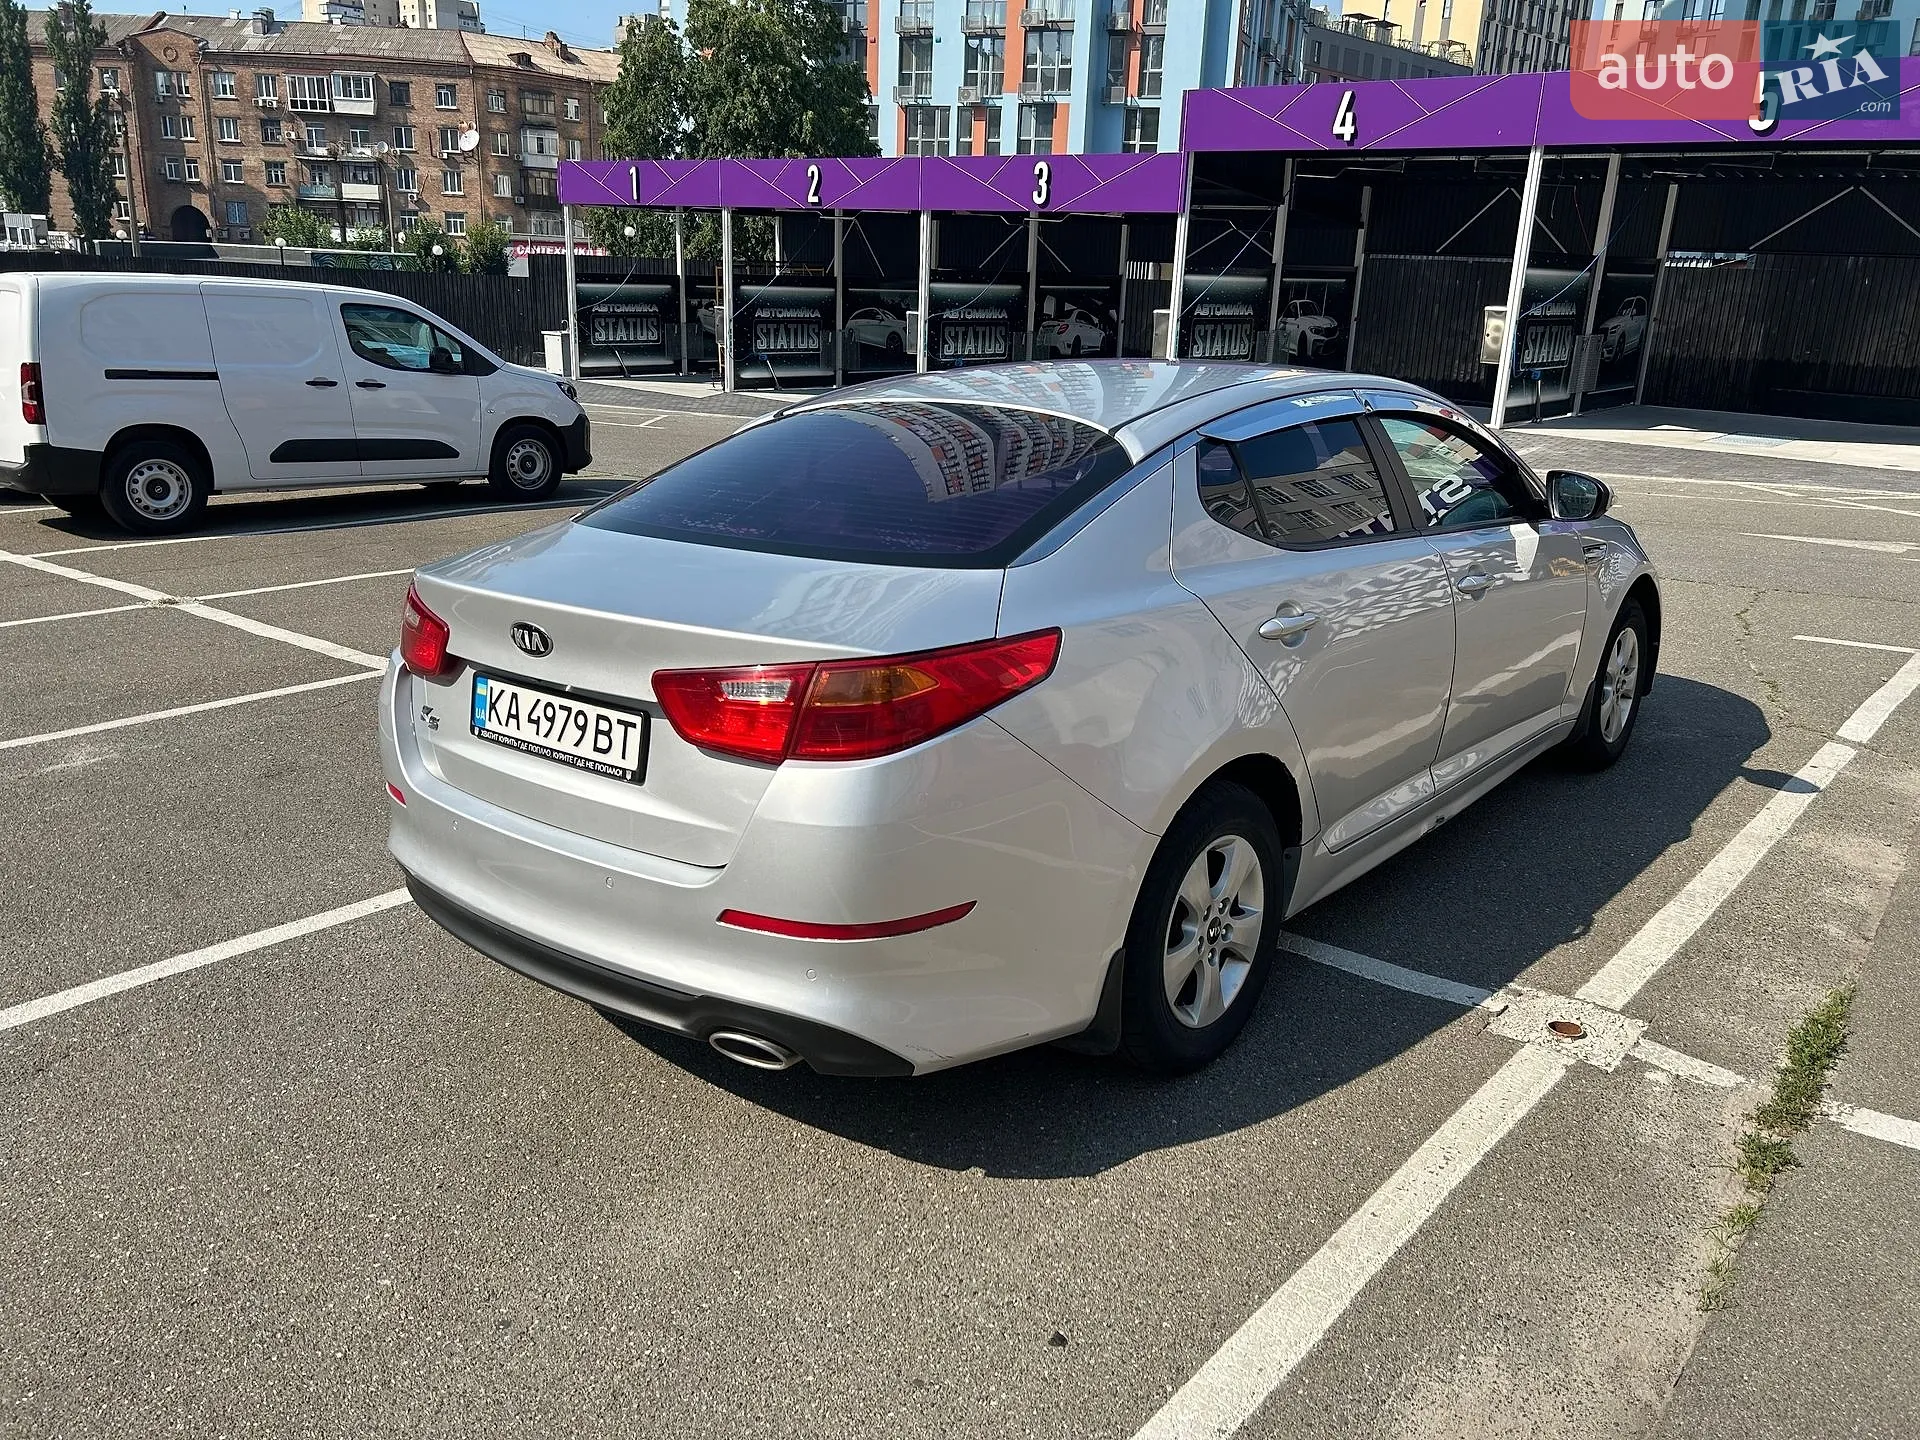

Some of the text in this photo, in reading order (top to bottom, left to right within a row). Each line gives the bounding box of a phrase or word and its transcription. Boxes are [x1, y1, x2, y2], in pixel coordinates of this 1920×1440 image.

[1332, 91, 1356, 142] 4
[1748, 71, 1778, 132] 5
[629, 166, 638, 201] 1
[808, 164, 820, 203] 2
[1032, 161, 1049, 205] 3
[594, 317, 658, 341] STATUS
[755, 307, 821, 317] АВТОМИЙКА
[756, 323, 819, 349] STATUS
[943, 326, 1006, 355] STATUS
[1192, 323, 1251, 357] STATUS
[1523, 325, 1573, 364] STATUS
[513, 627, 545, 652] KIA
[475, 708, 486, 720] UA
[488, 686, 637, 760] KA 4979 BT
[517, 740, 528, 751] ГДЕ
[573, 757, 585, 768] ГДЕ
[586, 760, 595, 770] НЕ
